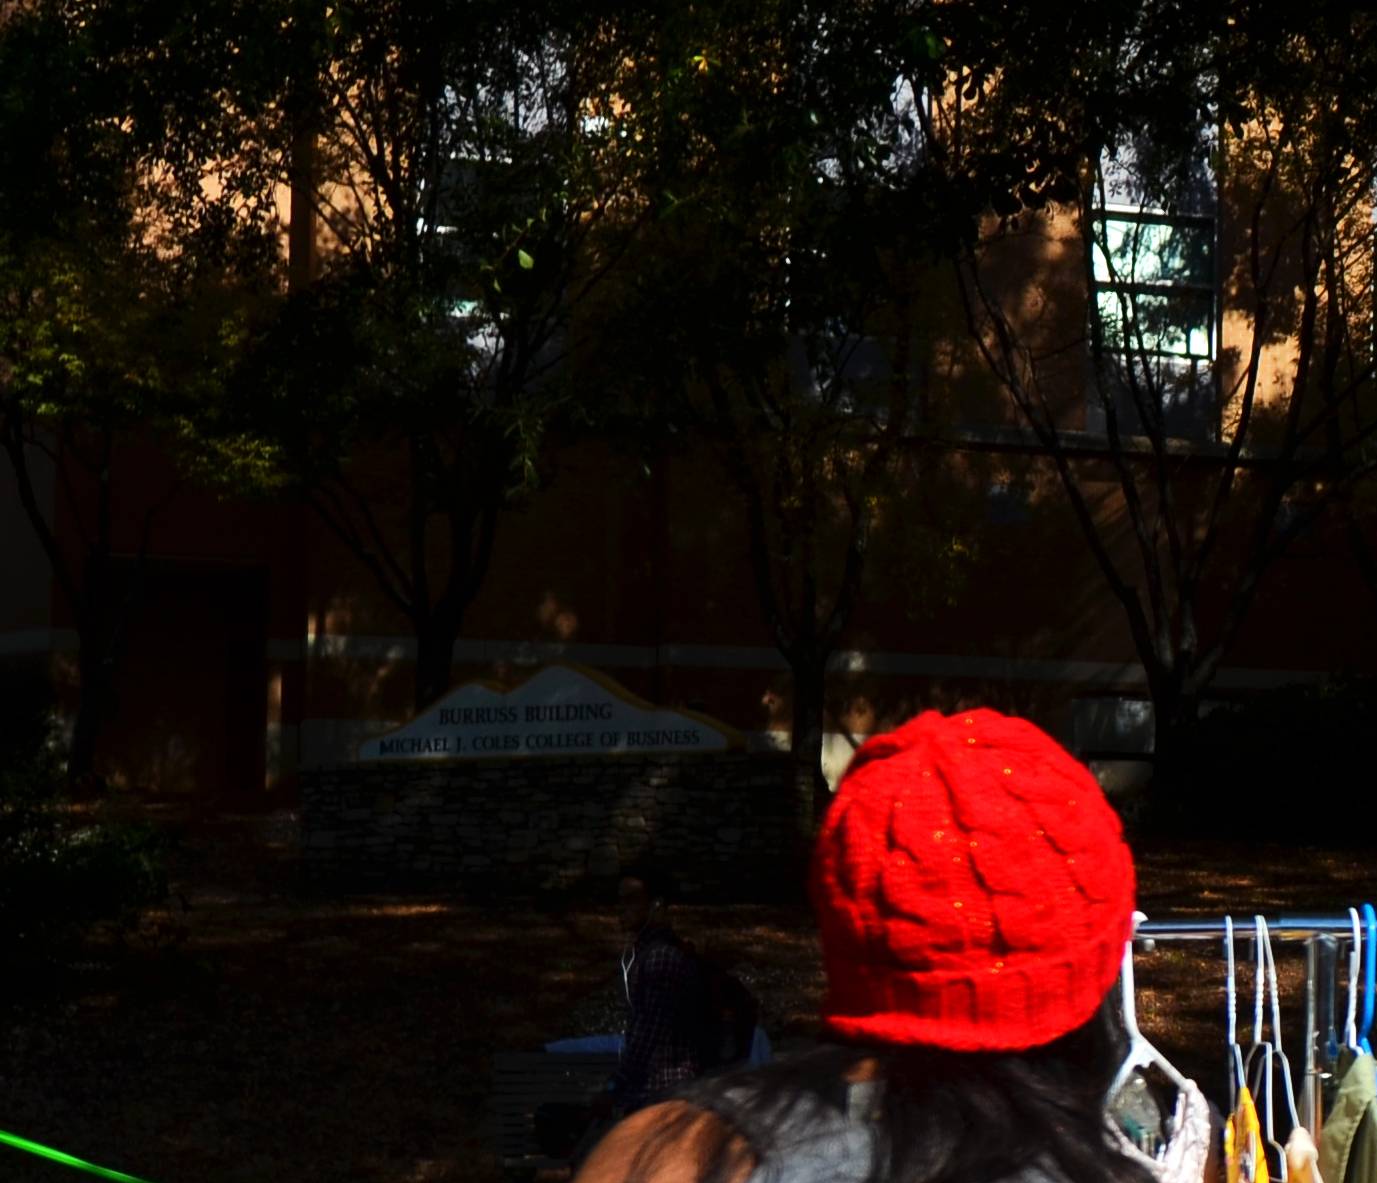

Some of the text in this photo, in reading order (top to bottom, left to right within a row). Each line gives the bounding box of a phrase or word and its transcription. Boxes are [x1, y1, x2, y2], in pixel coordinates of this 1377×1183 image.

[440, 703, 611, 725] BURRUSS BUILDING
[380, 729, 700, 755] MICHAEL J. COLES COLLEGE OF BUSINESS
